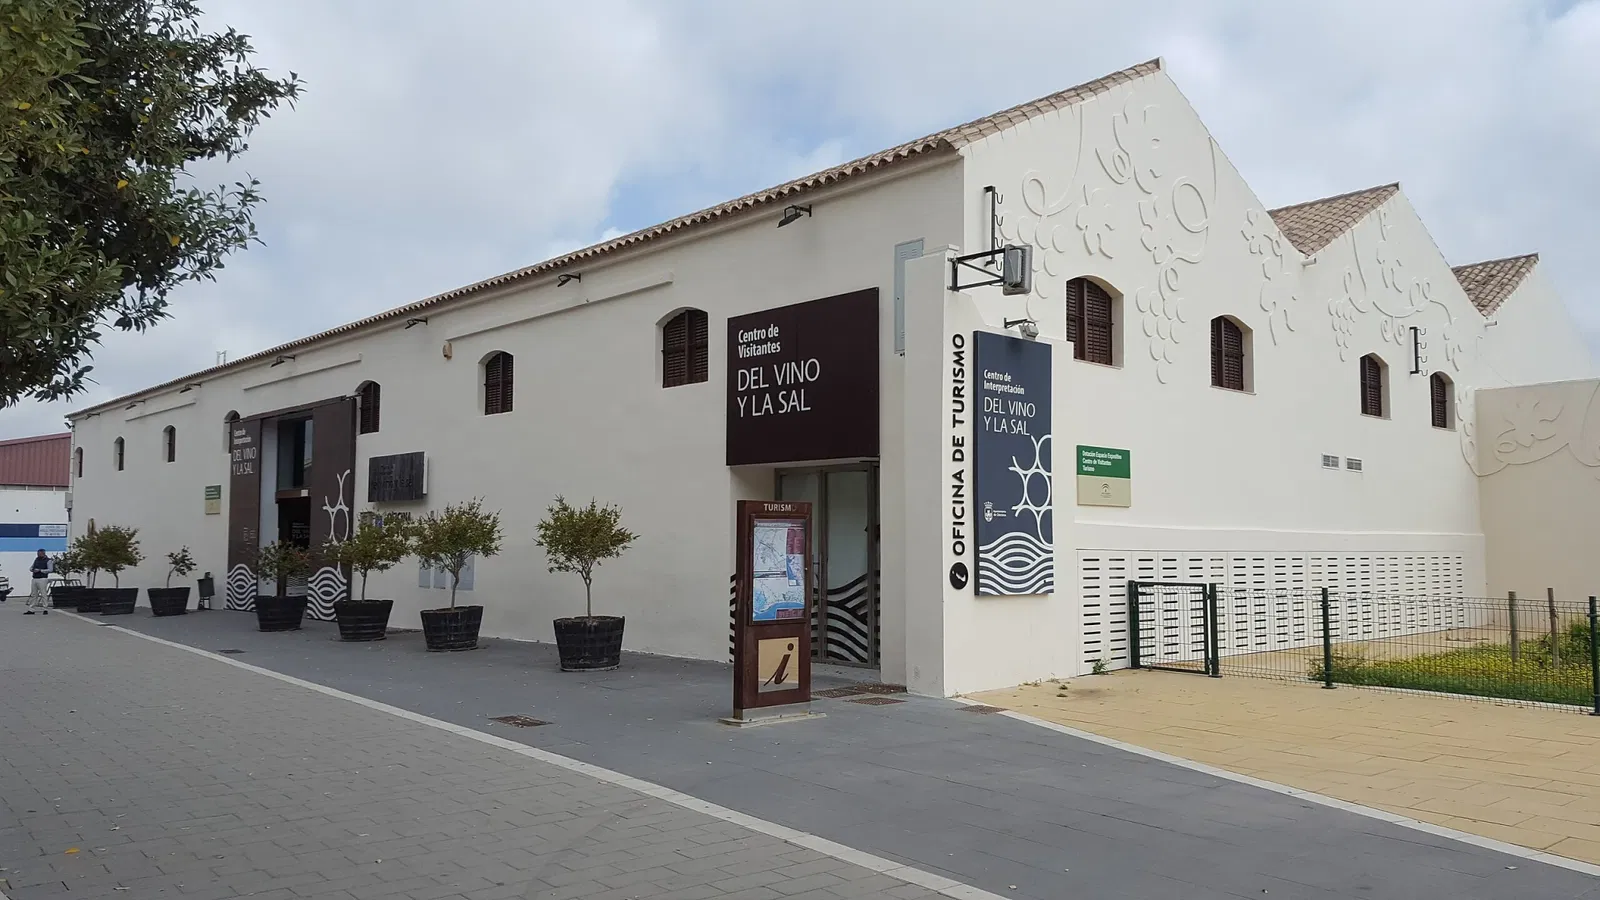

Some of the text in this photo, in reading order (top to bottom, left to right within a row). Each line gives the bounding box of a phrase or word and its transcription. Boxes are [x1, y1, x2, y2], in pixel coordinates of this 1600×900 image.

[738, 324, 779, 343] Centro de
[738, 341, 780, 358] Visitantes
[738, 358, 820, 391] DEL VINO
[952, 333, 965, 428] TURISMO
[984, 369, 1011, 382] Centro de
[984, 380, 1024, 394] Interpretación
[737, 388, 811, 417] Y LA SAL
[984, 397, 1036, 417] DEL VINO
[984, 416, 1030, 435] Y LA SAL
[233, 446, 257, 461] DEL VINO
[952, 435, 964, 462] DE
[952, 469, 965, 556] OFICINA
